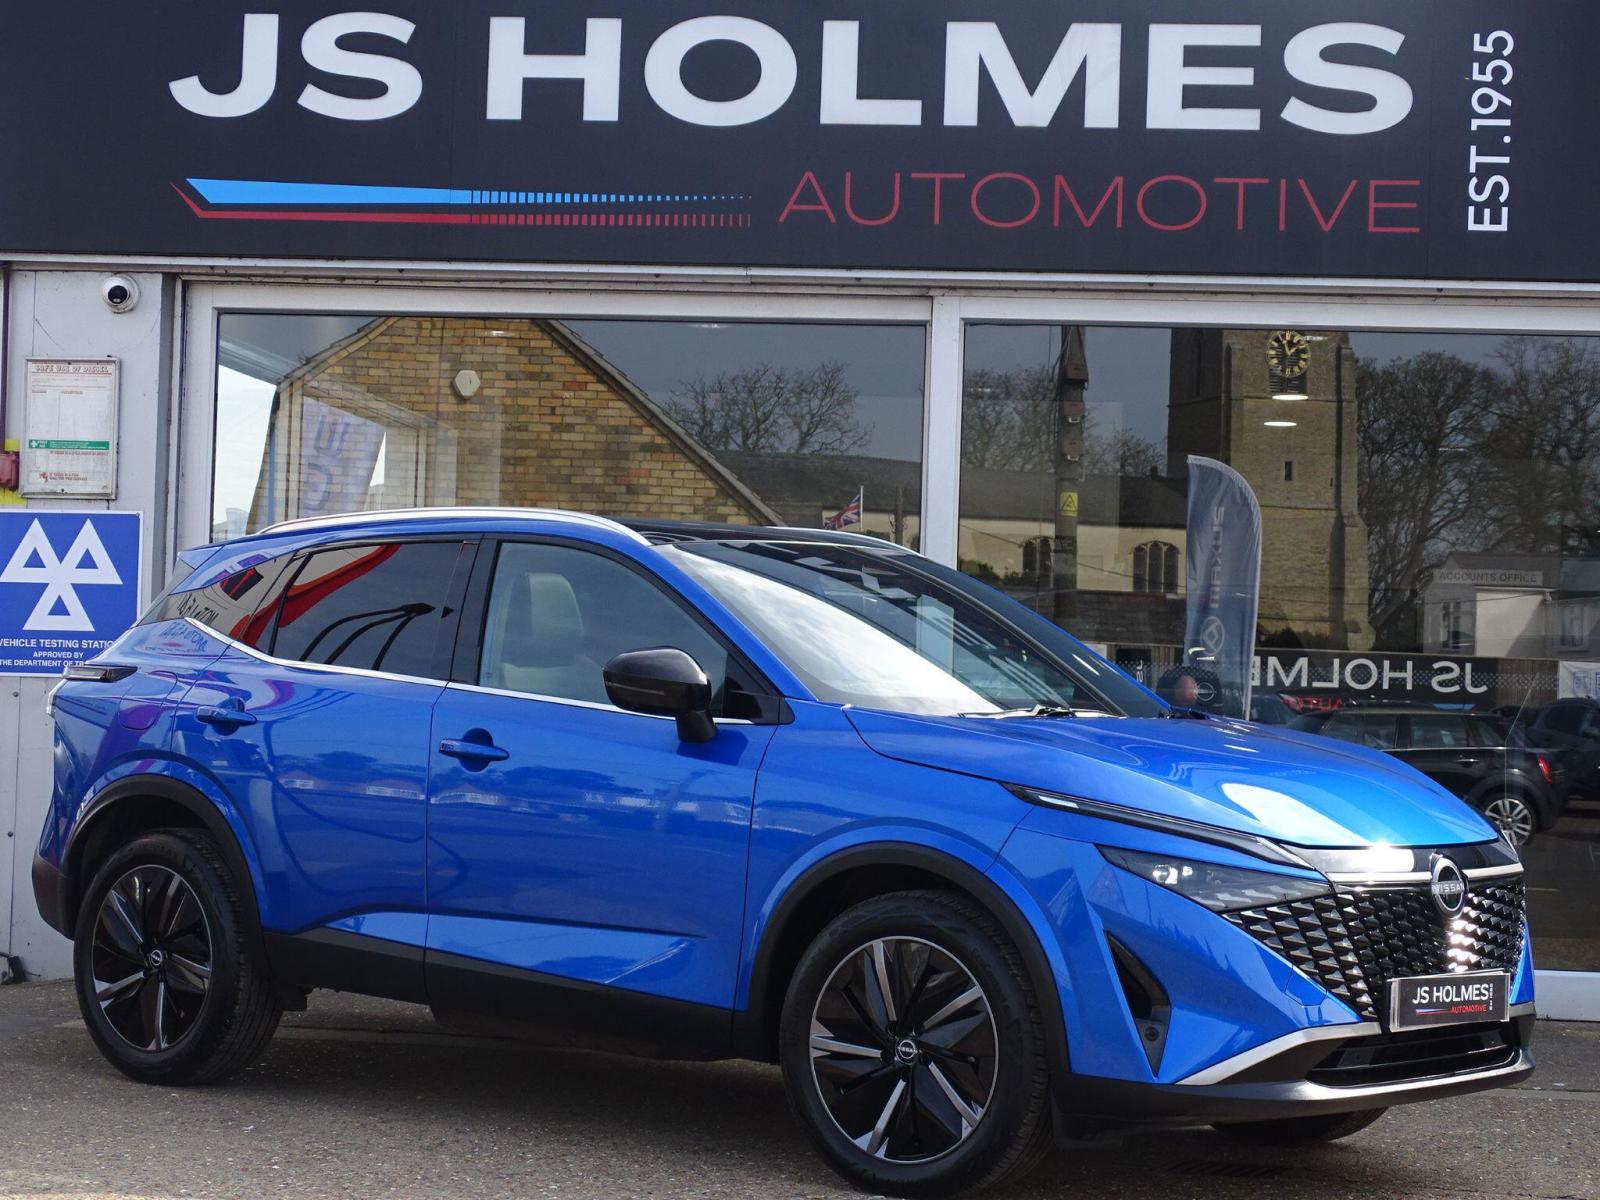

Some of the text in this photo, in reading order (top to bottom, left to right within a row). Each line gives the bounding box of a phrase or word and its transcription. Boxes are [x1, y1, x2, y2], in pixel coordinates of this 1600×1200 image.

[168, 12, 1414, 135] JS HOLMES
[779, 171, 1421, 234] AUTOMOTIVE
[1499, 572, 1538, 583] OFFICE
[39, 639, 80, 649] TESTING
[33, 650, 84, 659] APPROVED BY
[0, 658, 13, 666] THE
[13, 659, 62, 667] DEPARTMENT
[1431, 883, 1465, 894] NISSAN
[1412, 985, 1430, 1005] JS
[1432, 983, 1489, 1003] HOLMES
[1450, 1004, 1488, 1015] AUTOMOTIVE
